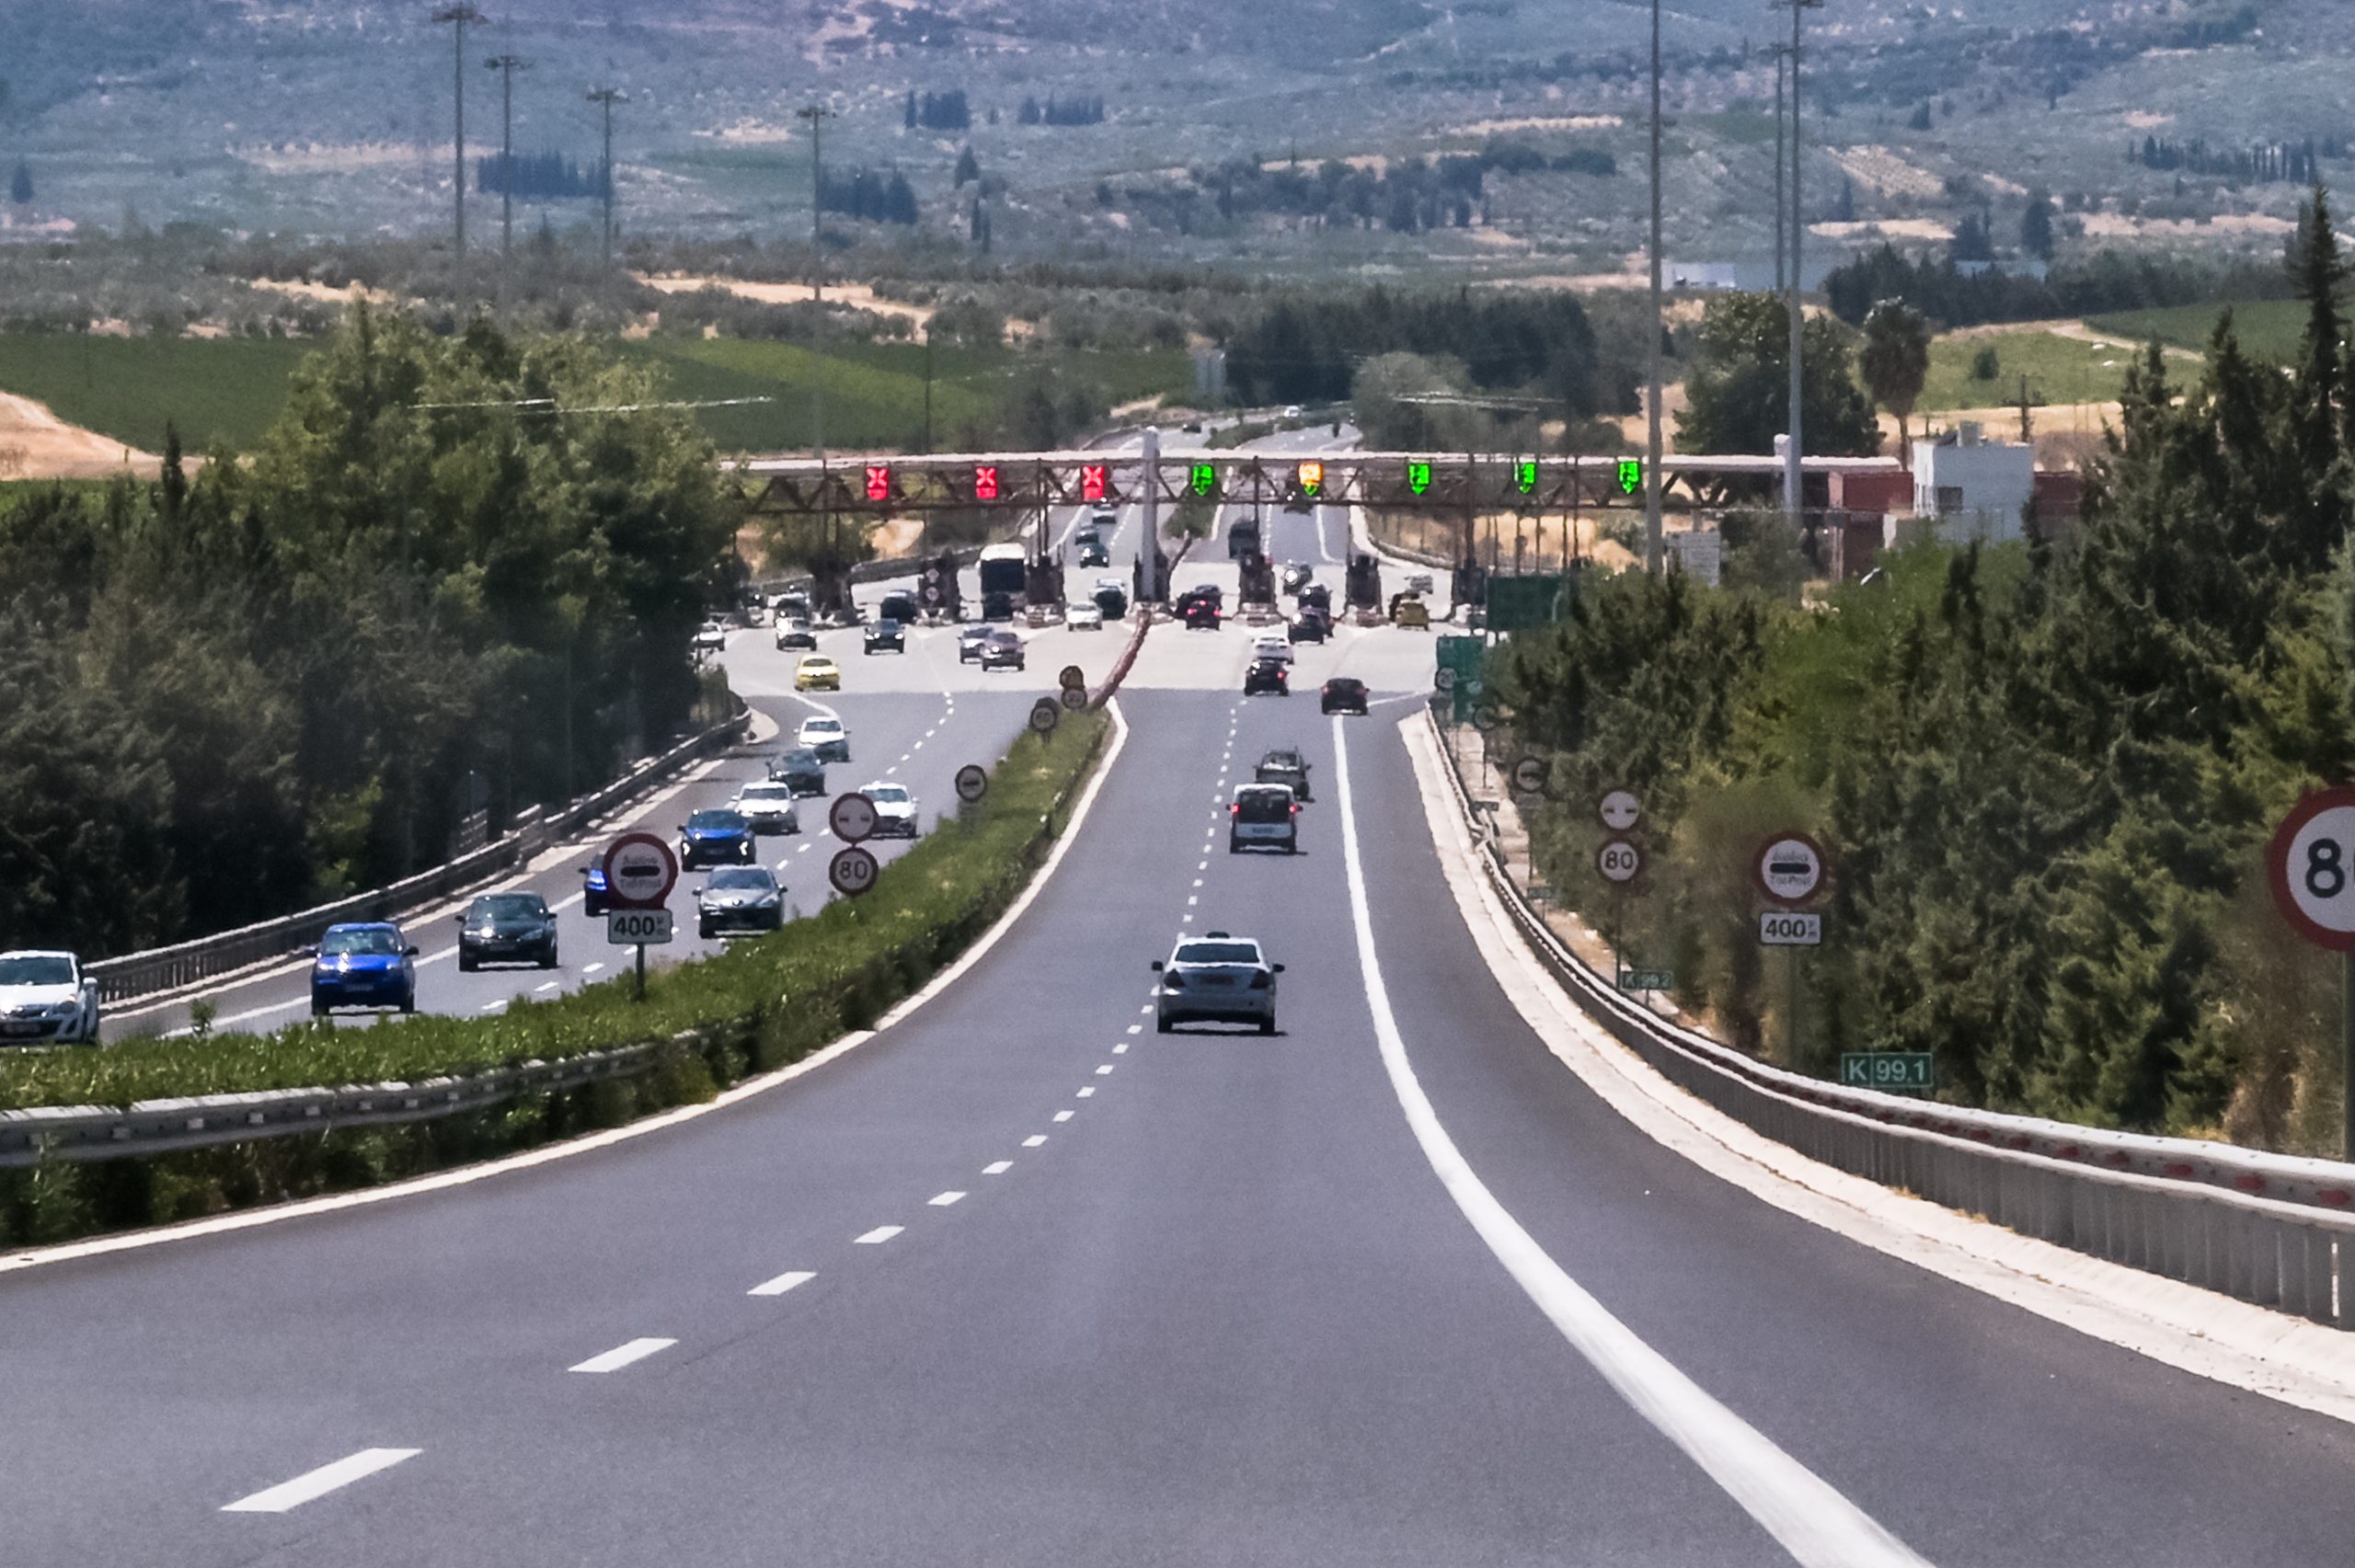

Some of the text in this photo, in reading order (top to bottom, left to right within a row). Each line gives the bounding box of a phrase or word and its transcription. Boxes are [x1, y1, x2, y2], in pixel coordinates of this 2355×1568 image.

[840, 861, 867, 879] 80
[1605, 851, 1634, 870] 80
[2306, 838, 2355, 898] 8
[615, 916, 655, 936] 400
[1765, 919, 1807, 938] 400
[1849, 1059, 1924, 1082] K 99.1
